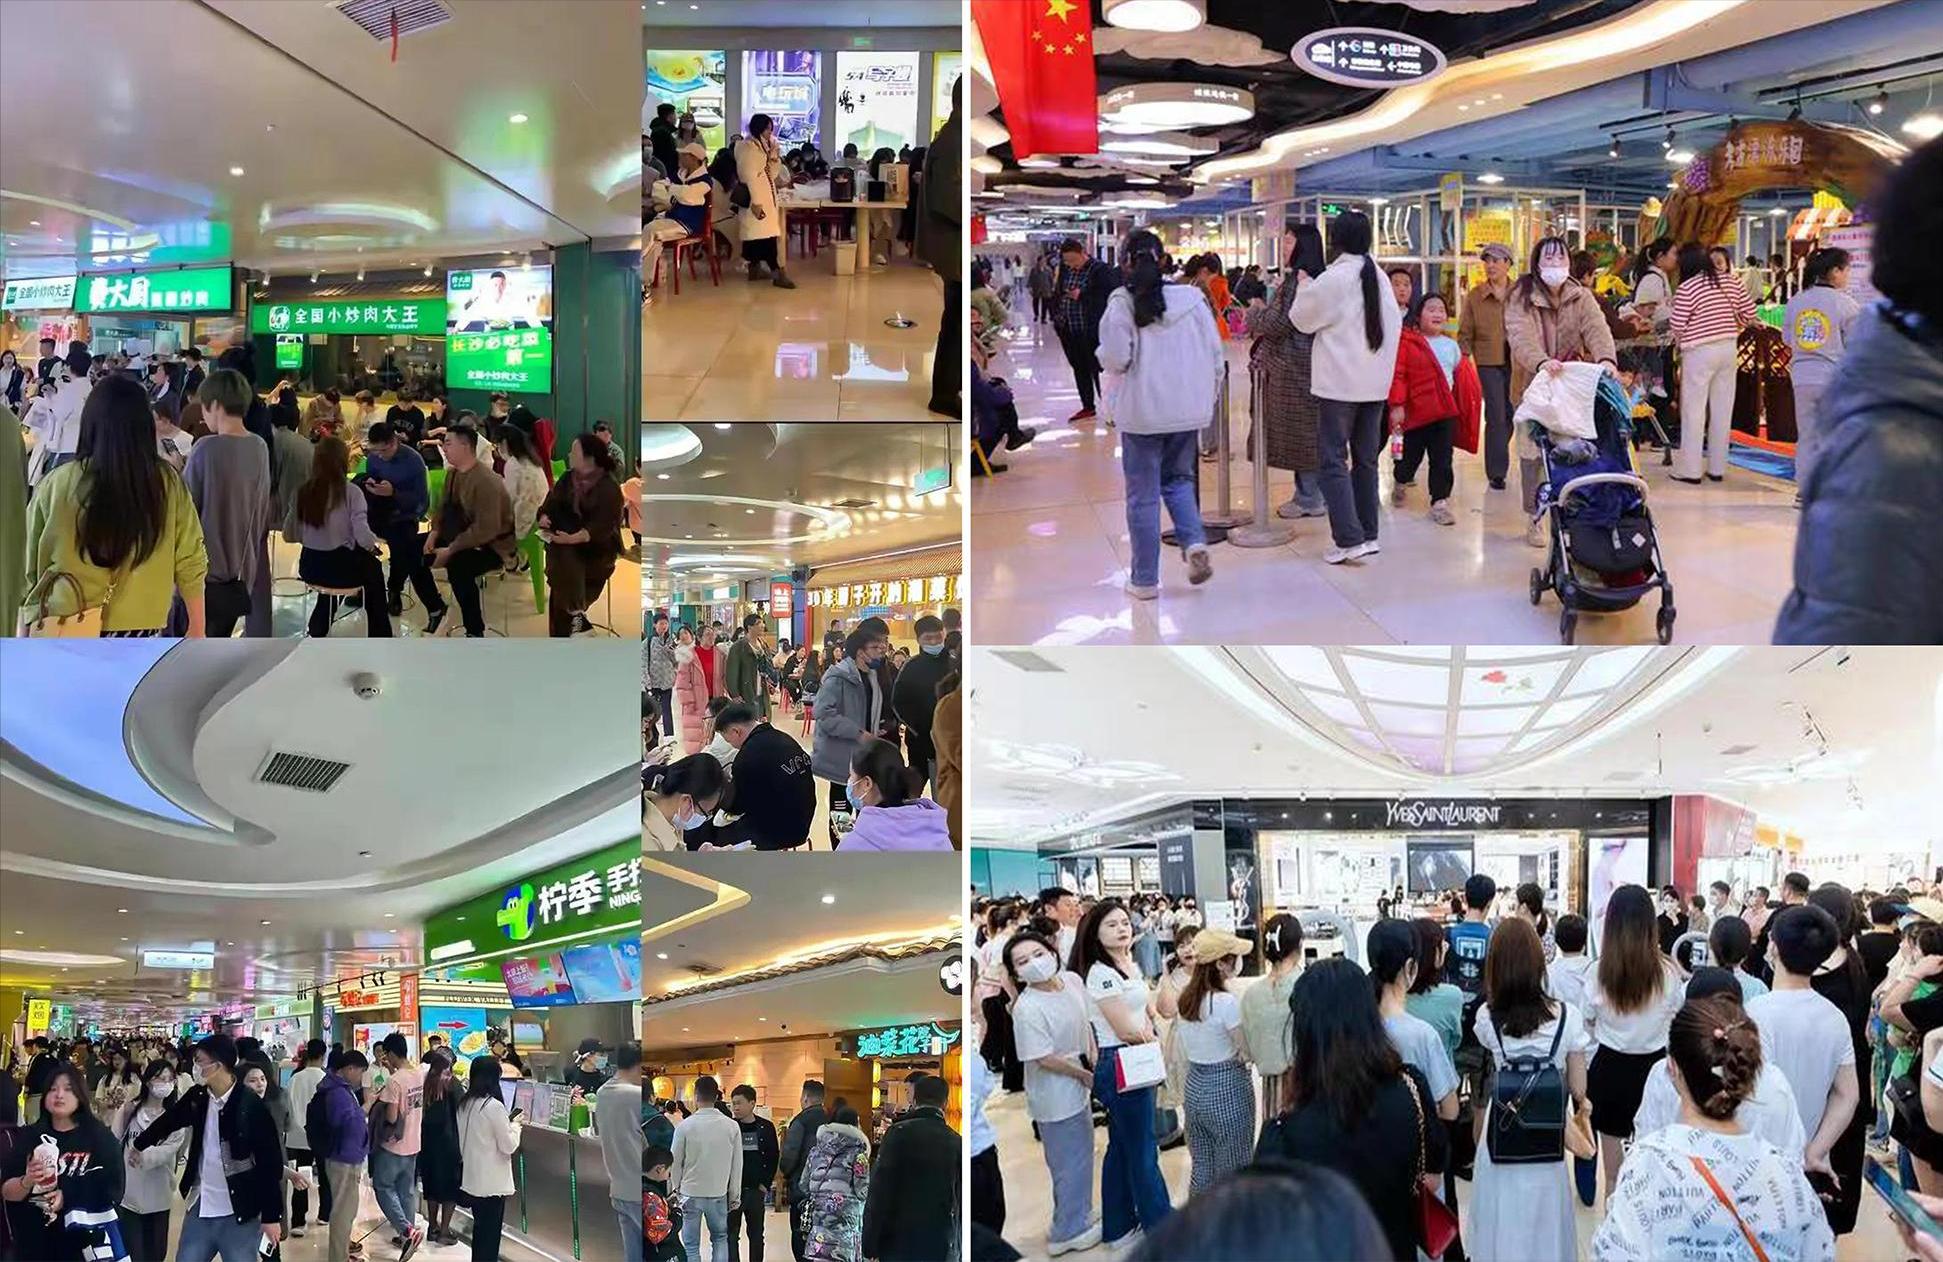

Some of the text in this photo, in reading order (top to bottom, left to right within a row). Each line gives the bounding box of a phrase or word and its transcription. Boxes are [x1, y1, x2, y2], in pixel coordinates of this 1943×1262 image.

[295, 305, 418, 324] 全国小炒肉大王
[538, 869, 602, 925] 柠季
